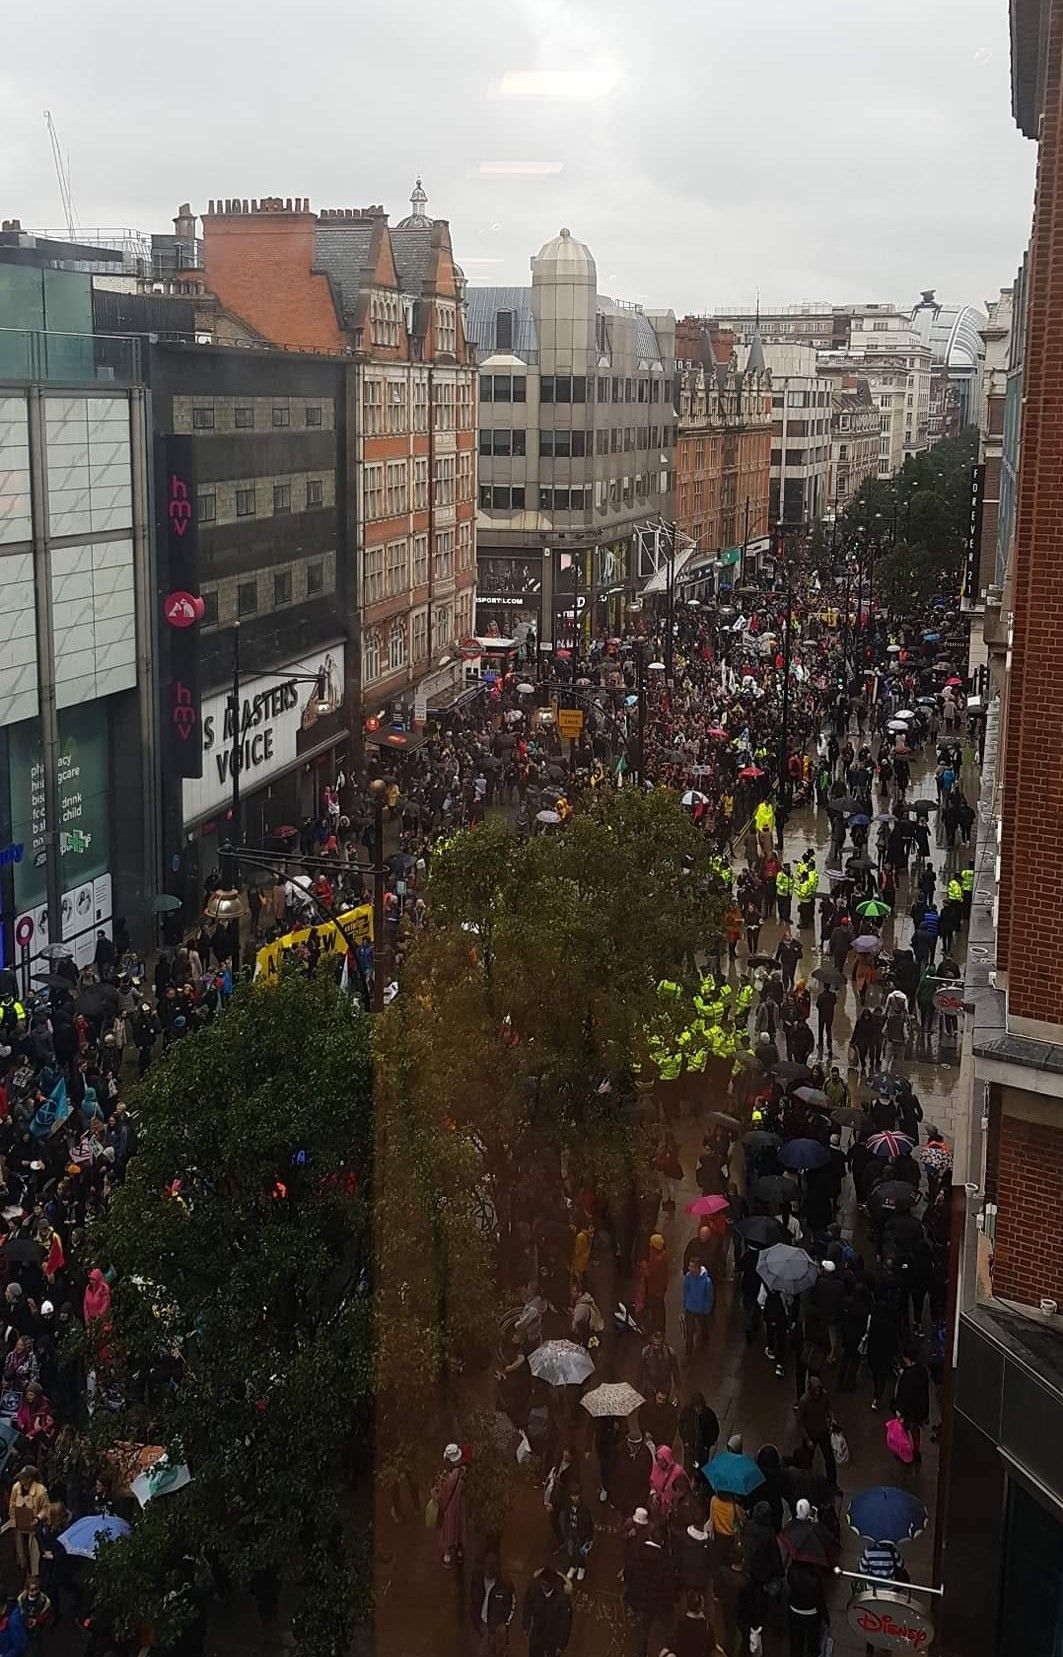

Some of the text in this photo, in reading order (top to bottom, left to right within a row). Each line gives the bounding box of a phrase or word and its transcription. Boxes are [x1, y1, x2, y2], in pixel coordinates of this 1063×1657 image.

[169, 474, 192, 536] hmv
[966, 468, 979, 594] FOREVER 21
[173, 682, 196, 739] hmv
[216, 728, 274, 785] VOICE
[62, 804, 82, 822] child
